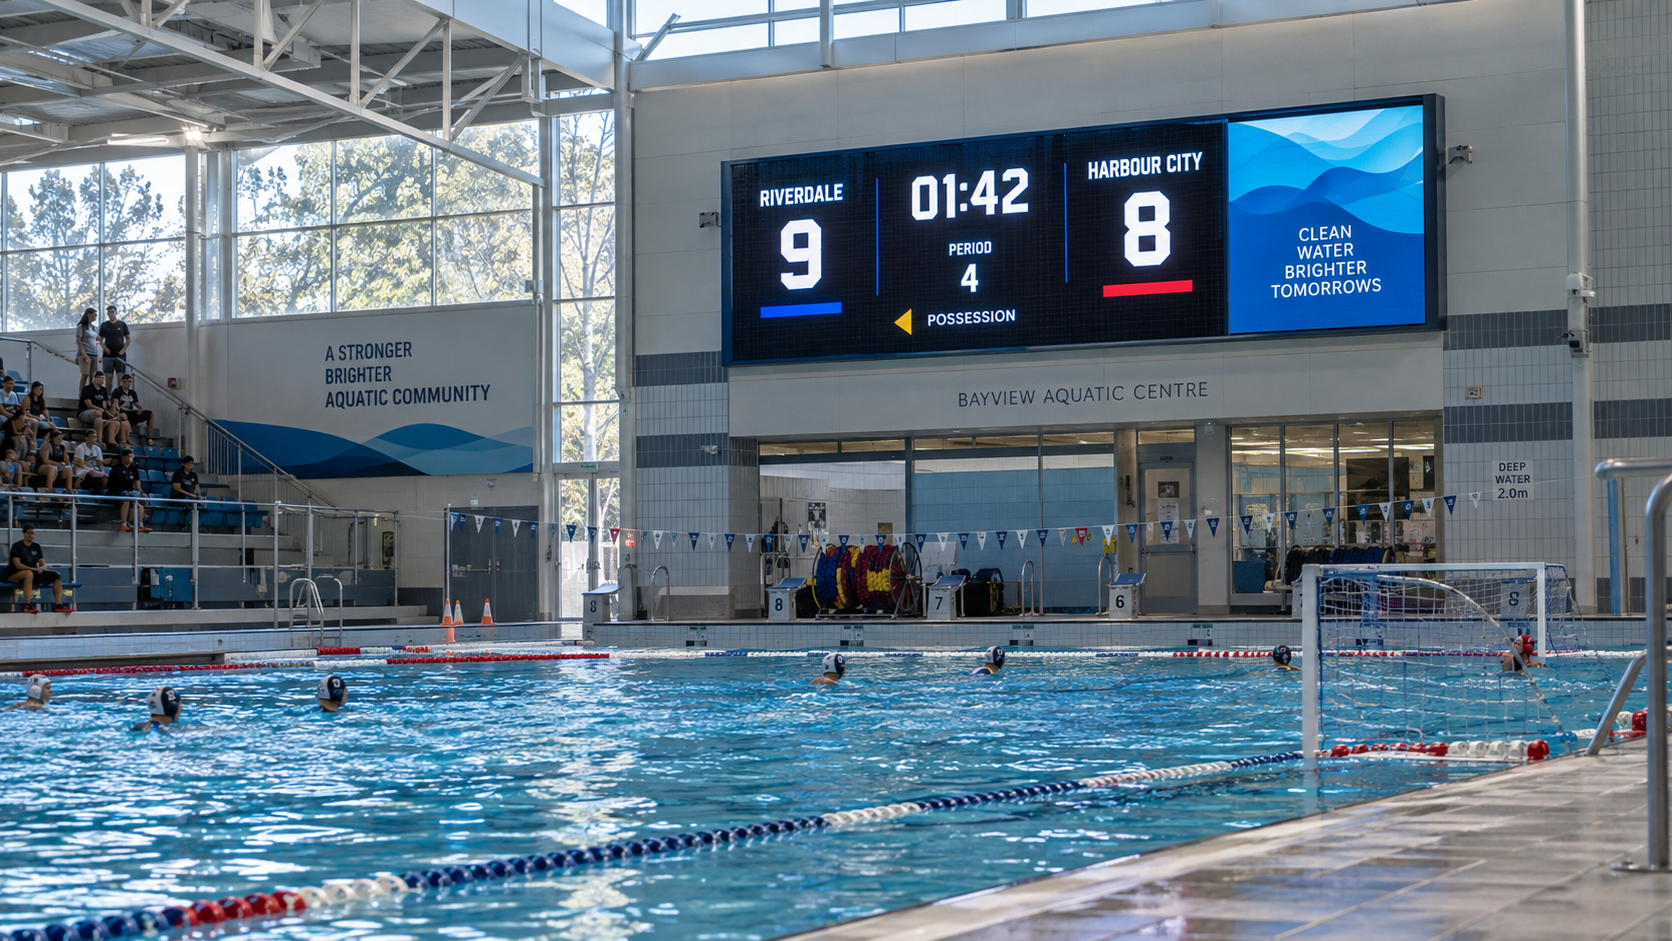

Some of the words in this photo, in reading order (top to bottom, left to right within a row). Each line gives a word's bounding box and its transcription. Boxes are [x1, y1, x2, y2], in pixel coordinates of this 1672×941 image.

[1088, 156, 1162, 180] HARBOUR
[1166, 151, 1203, 174] CITY
[759, 184, 844, 208] RIVERDALE
[911, 167, 1029, 222] 01:42
[1123, 190, 1171, 267] 8
[1299, 225, 1352, 242] CLEAN
[780, 218, 824, 290] 9
[948, 240, 992, 257] PERIOD
[1297, 243, 1354, 260] WATER
[960, 264, 979, 293] 4
[1285, 260, 1367, 279] BRIGHTER
[1271, 278, 1382, 299] TOMORROWS
[927, 309, 1016, 327] POSSESSION
[325, 345, 335, 362] A
[338, 341, 413, 361] STRONGER
[325, 365, 392, 385] BRIGHTER
[325, 389, 388, 410] AQUATIC
[392, 384, 491, 405] COMMUNITY
[958, 389, 1036, 408] BAYVIEW
[1042, 385, 1124, 406] AQUATIC
[1133, 381, 1209, 400] CENTRE
[1498, 461, 1526, 472] DEEP
[1494, 474, 1531, 485] WATER
[1497, 487, 1529, 499] 2.0m
[774, 597, 783, 612] 8
[934, 596, 944, 611] 7
[1115, 594, 1125, 609] 6
